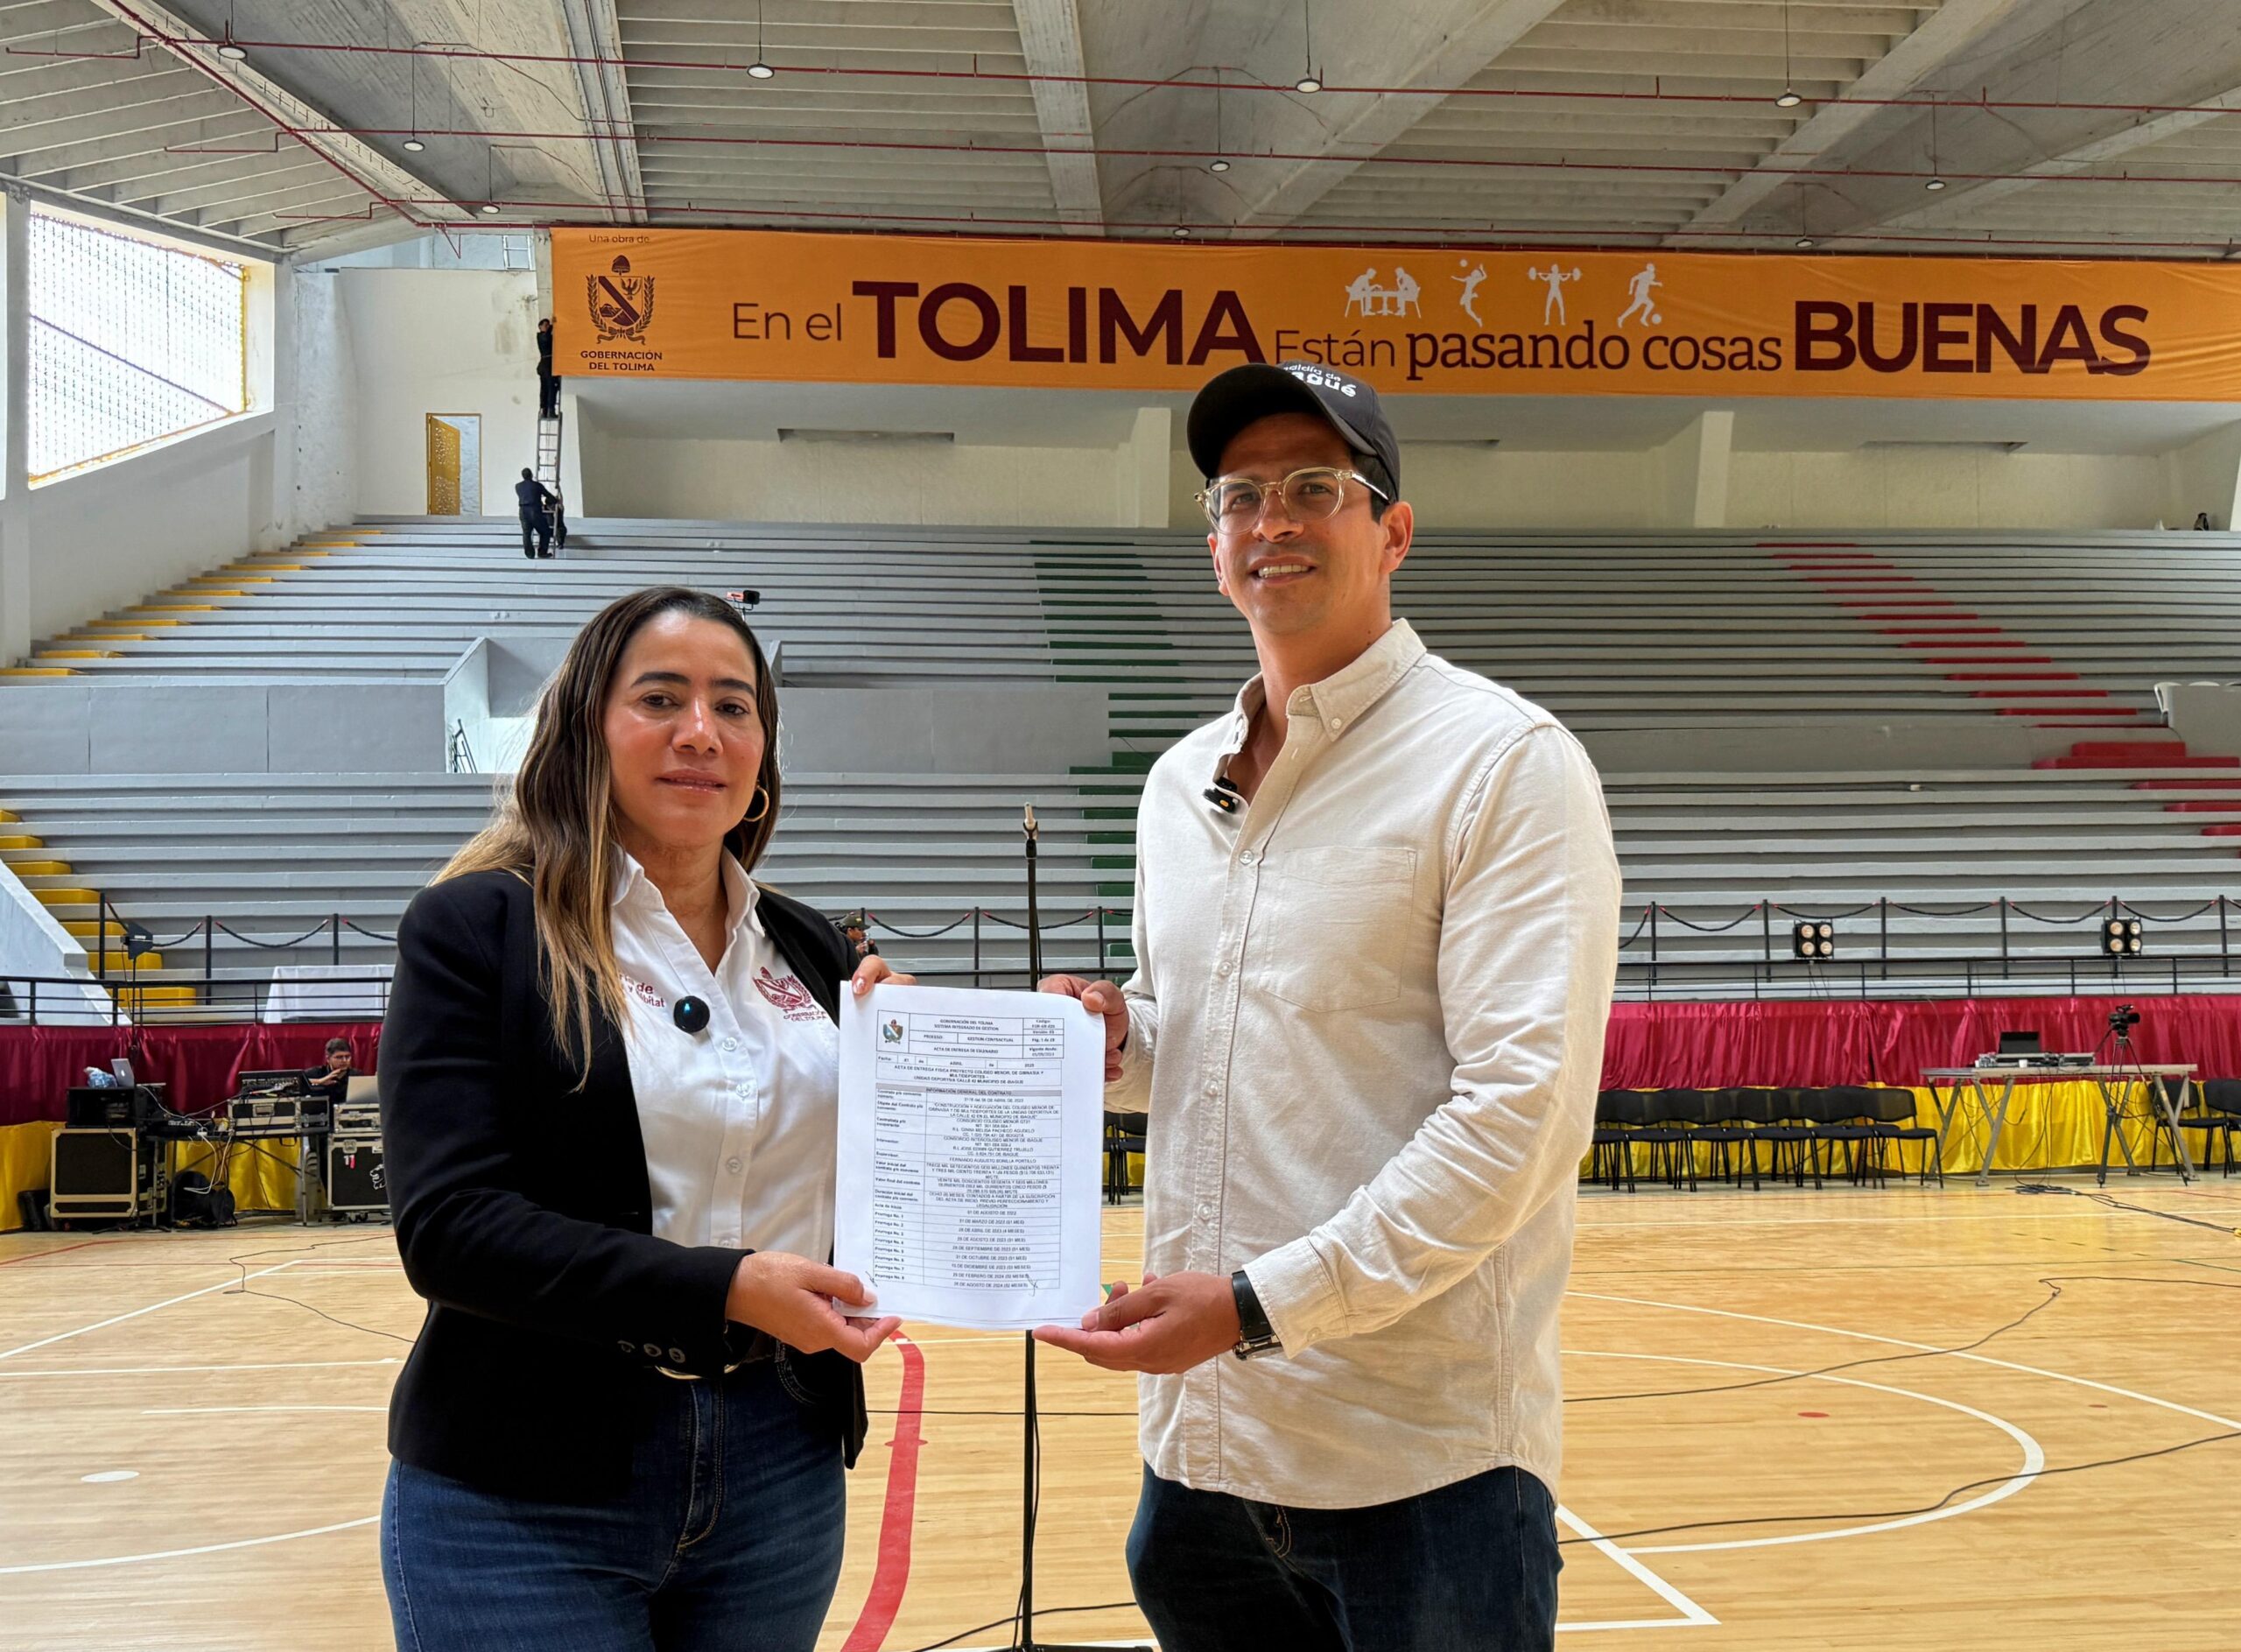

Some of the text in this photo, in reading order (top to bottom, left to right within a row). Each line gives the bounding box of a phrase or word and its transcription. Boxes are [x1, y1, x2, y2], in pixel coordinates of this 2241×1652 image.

[612, 235, 634, 243] obra
[733, 280, 2151, 381] En el TOLIMA Están pasando cosas BUENAS
[580, 350, 663, 361] GOBERNACIÓN
[588, 362, 655, 371] DEL TOLIMA
[636, 981, 654, 995] de
